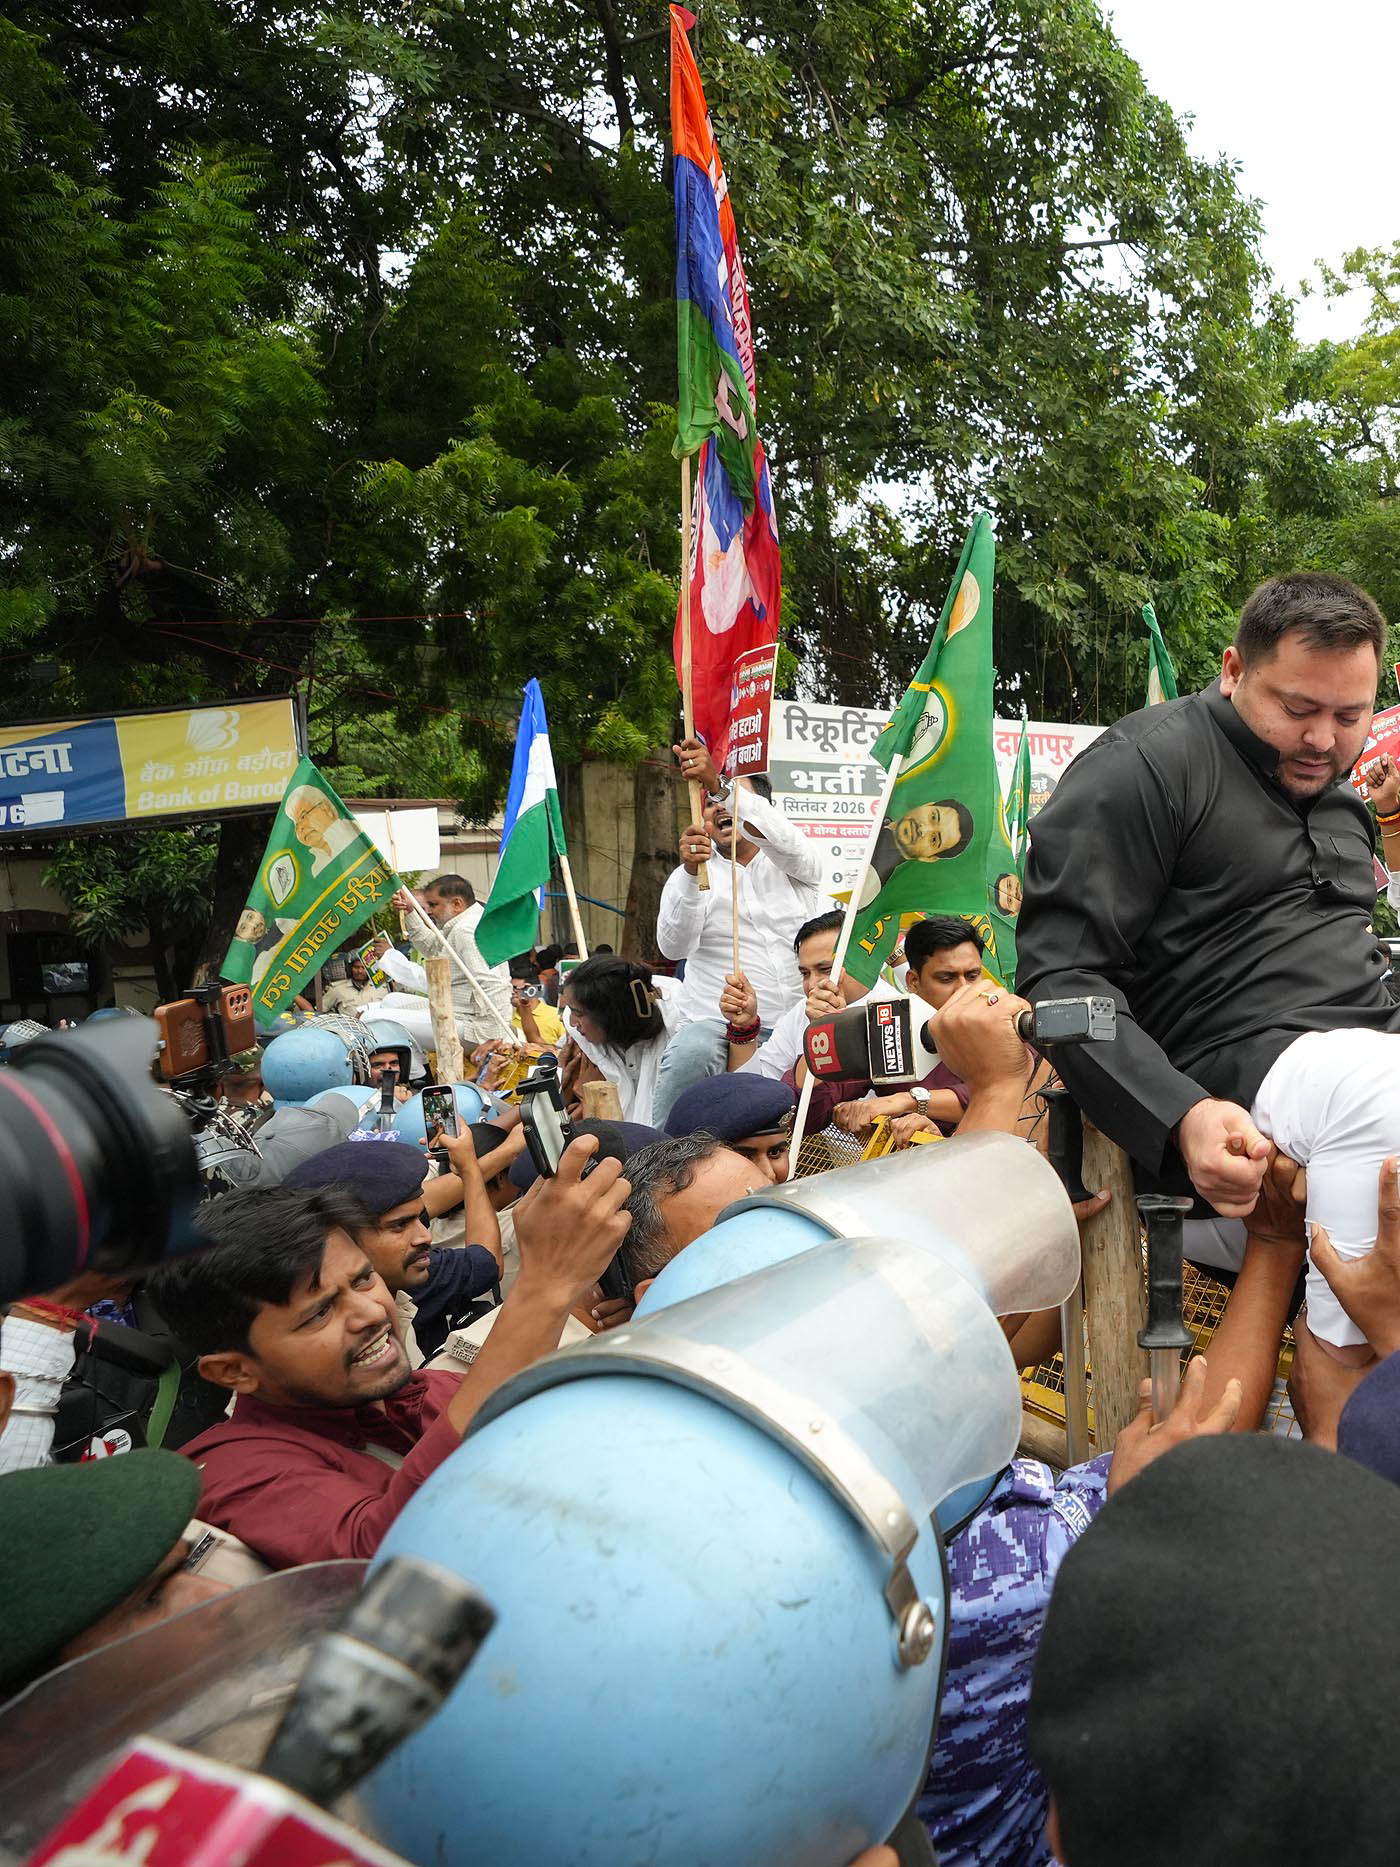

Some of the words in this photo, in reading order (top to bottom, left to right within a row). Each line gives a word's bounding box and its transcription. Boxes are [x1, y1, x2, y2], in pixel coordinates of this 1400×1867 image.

[0, 742, 73, 778] टना
[140, 759, 176, 784] बैंक
[137, 786, 195, 811] Bank
[199, 783, 221, 804] of
[224, 775, 289, 801] Barod
[790, 765, 867, 795] भर्ती
[783, 797, 828, 813] सितंबर
[833, 801, 865, 814] 2026
[811, 1031, 833, 1071] 18
